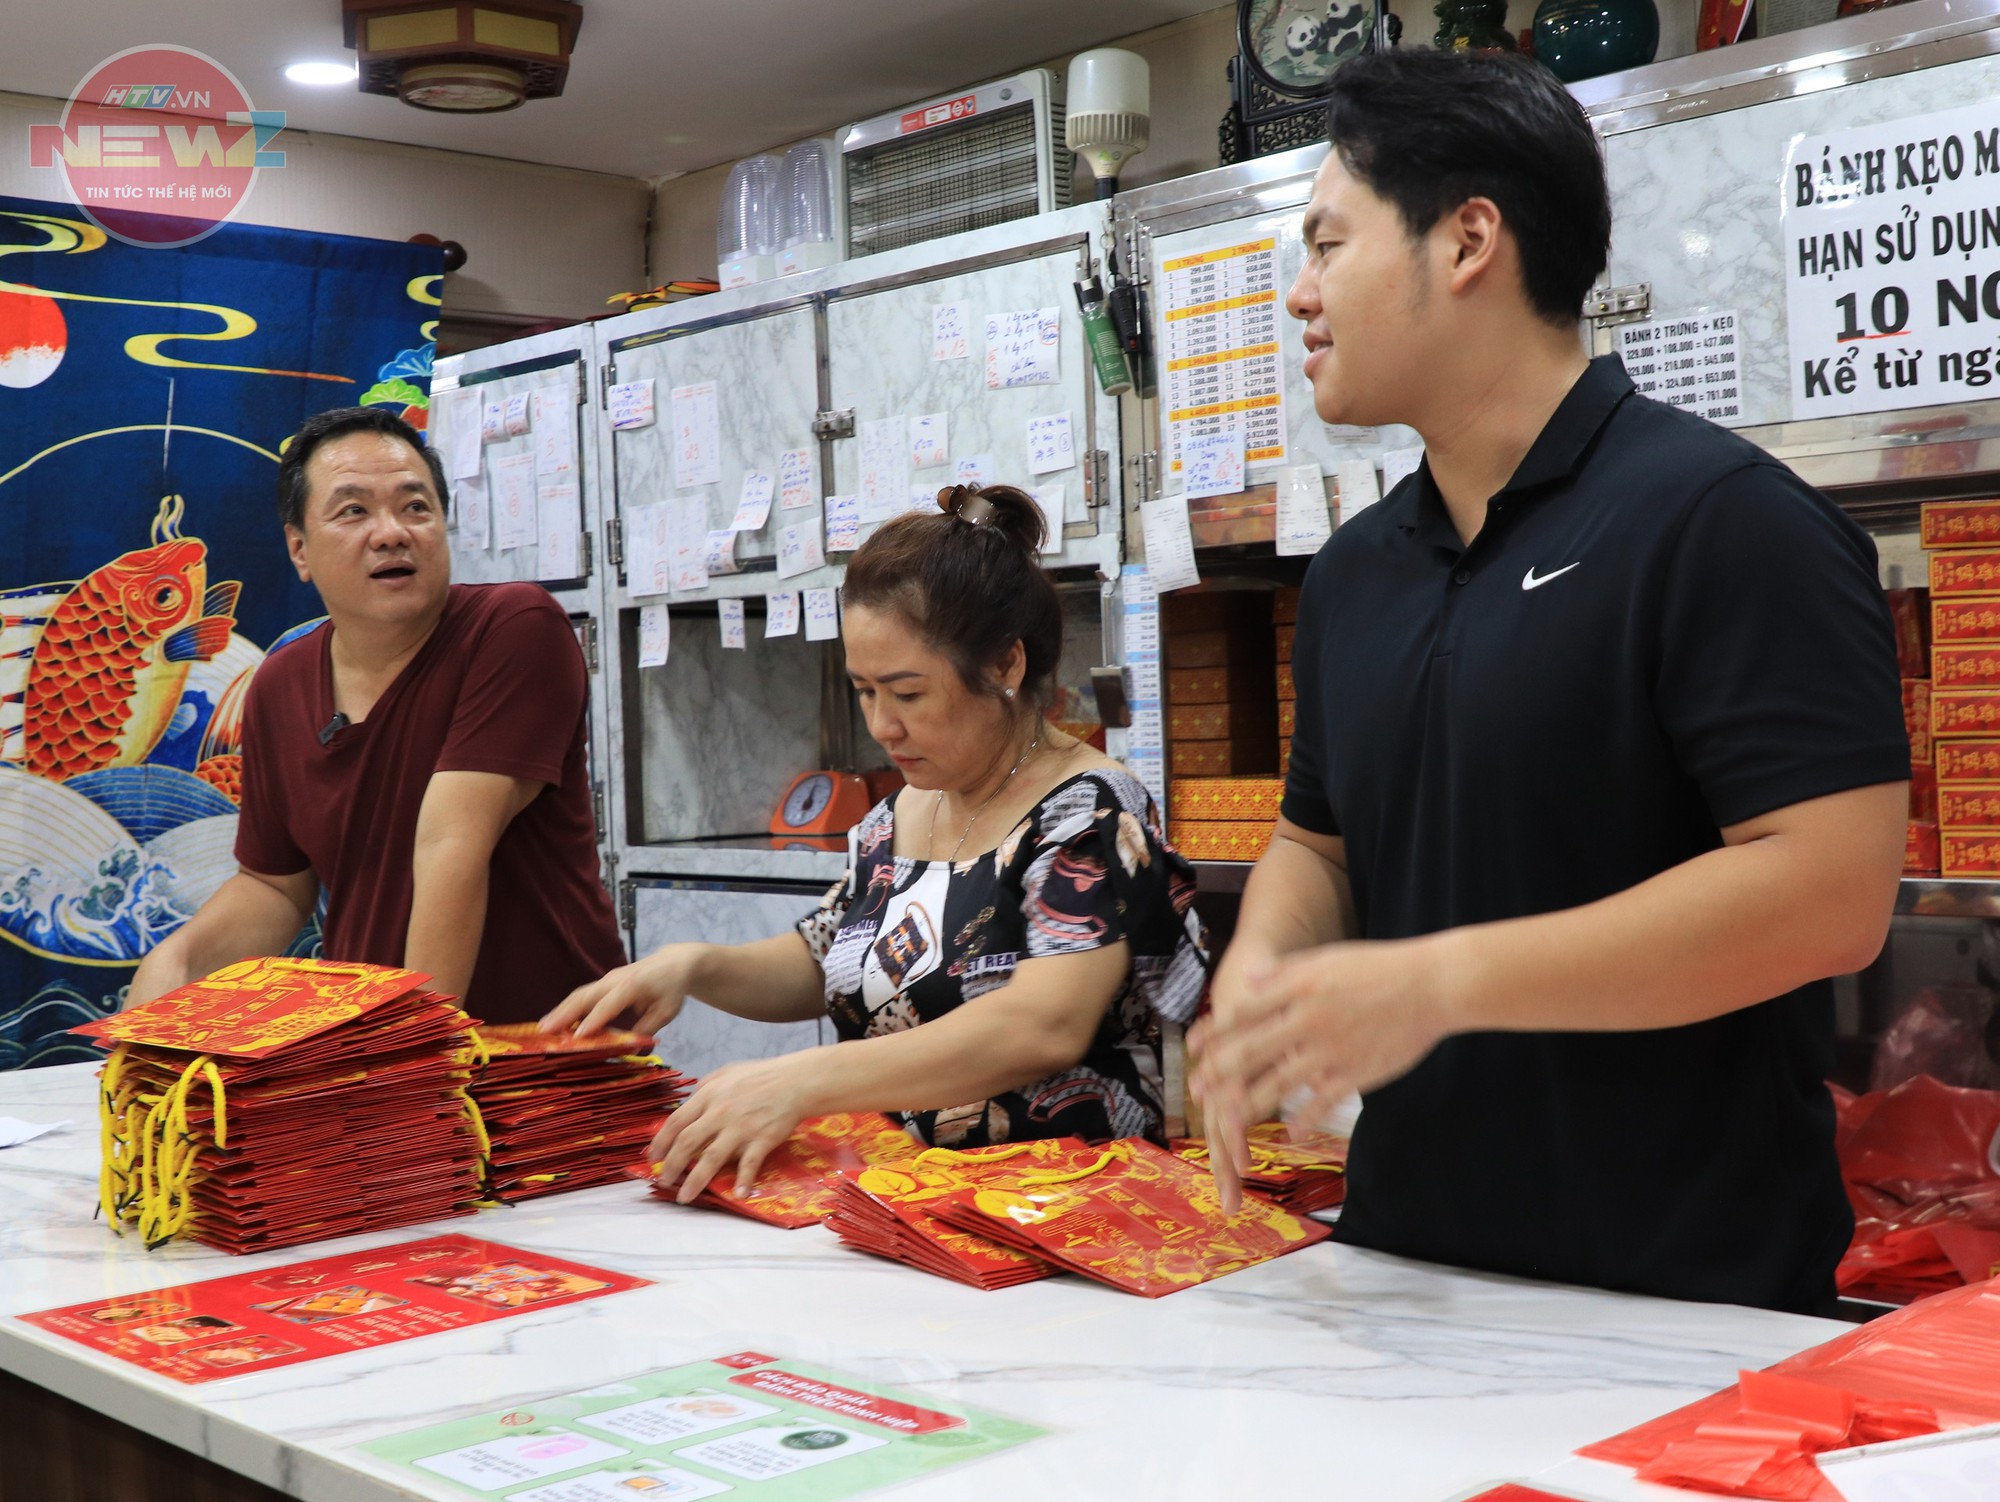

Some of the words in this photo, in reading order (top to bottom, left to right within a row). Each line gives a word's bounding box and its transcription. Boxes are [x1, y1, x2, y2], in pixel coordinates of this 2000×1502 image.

[1895, 134, 1965, 195] KẸO
[1798, 228, 1864, 282] HẠN
[1875, 204, 1920, 265] SỬ
[1624, 328, 1651, 344] BÁNH
[1655, 328, 1660, 339] 2
[1664, 321, 1698, 338] TRỨNG
[1713, 316, 1733, 332] KẸO
[1834, 286, 1910, 341] 10
[1804, 346, 1860, 399] Kể
[1873, 348, 1924, 390] từ
[1939, 334, 2000, 387] ng
